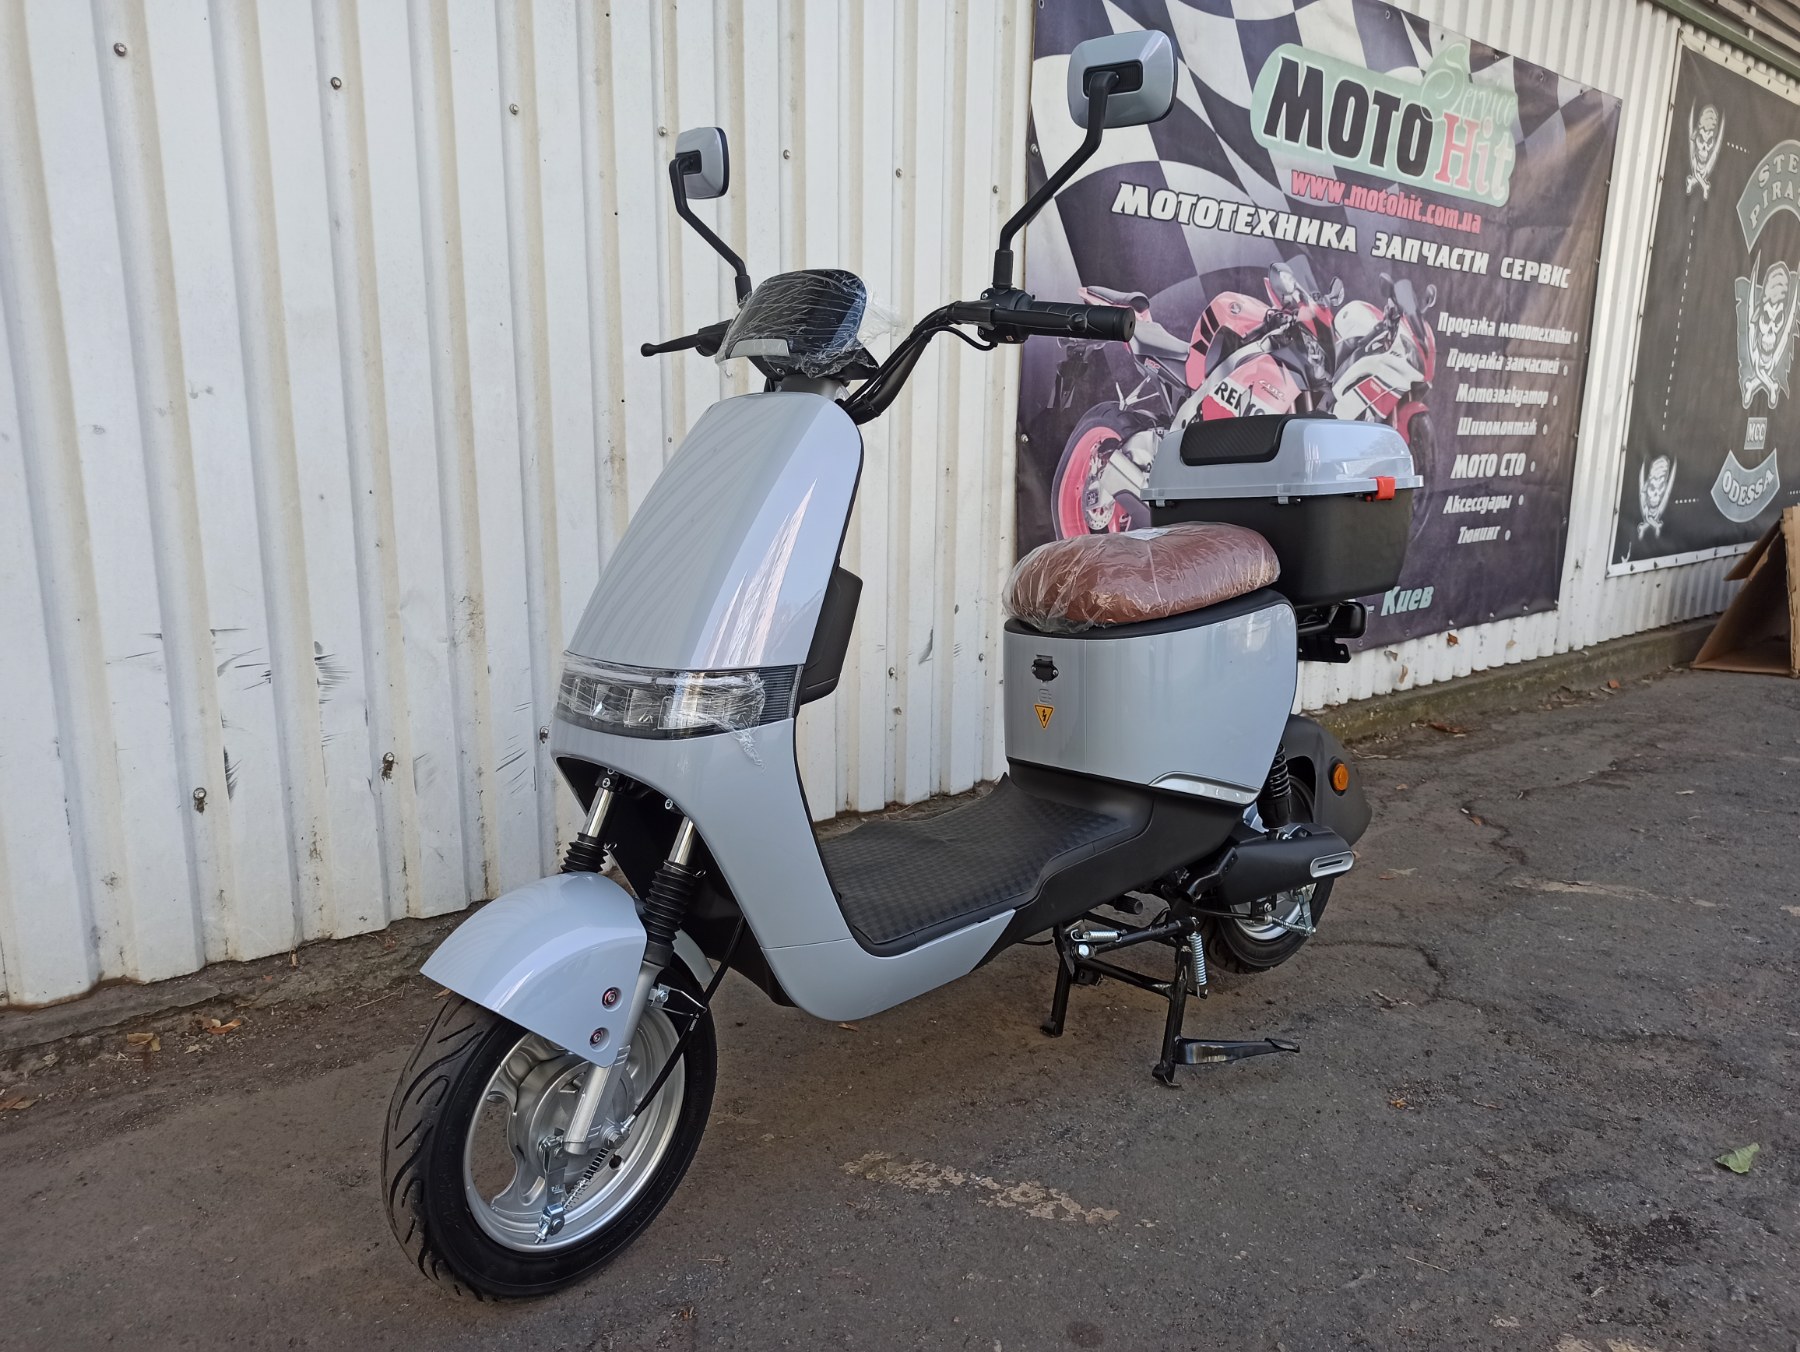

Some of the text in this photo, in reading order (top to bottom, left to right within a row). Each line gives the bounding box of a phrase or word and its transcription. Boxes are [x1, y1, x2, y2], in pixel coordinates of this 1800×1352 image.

[1290, 169, 1482, 235] www.motohit.com.ua
[1750, 180, 1800, 229] PIRA
[1111, 182, 1571, 289] МОТОТЕХНИКА ЗАПЧАСТИ СЕРВИС
[1437, 311, 1573, 345] Продажа мототехники
[1446, 348, 1560, 375] Продажа запчастей
[1456, 417, 1537, 436] Шиномонтаж
[1450, 452, 1526, 479] МОТО СТО
[1722, 469, 1775, 506] ODESSA
[1443, 494, 1513, 514] Аксессуары
[1457, 526, 1501, 544] Тюнинг
[1380, 585, 1434, 617] Киев
